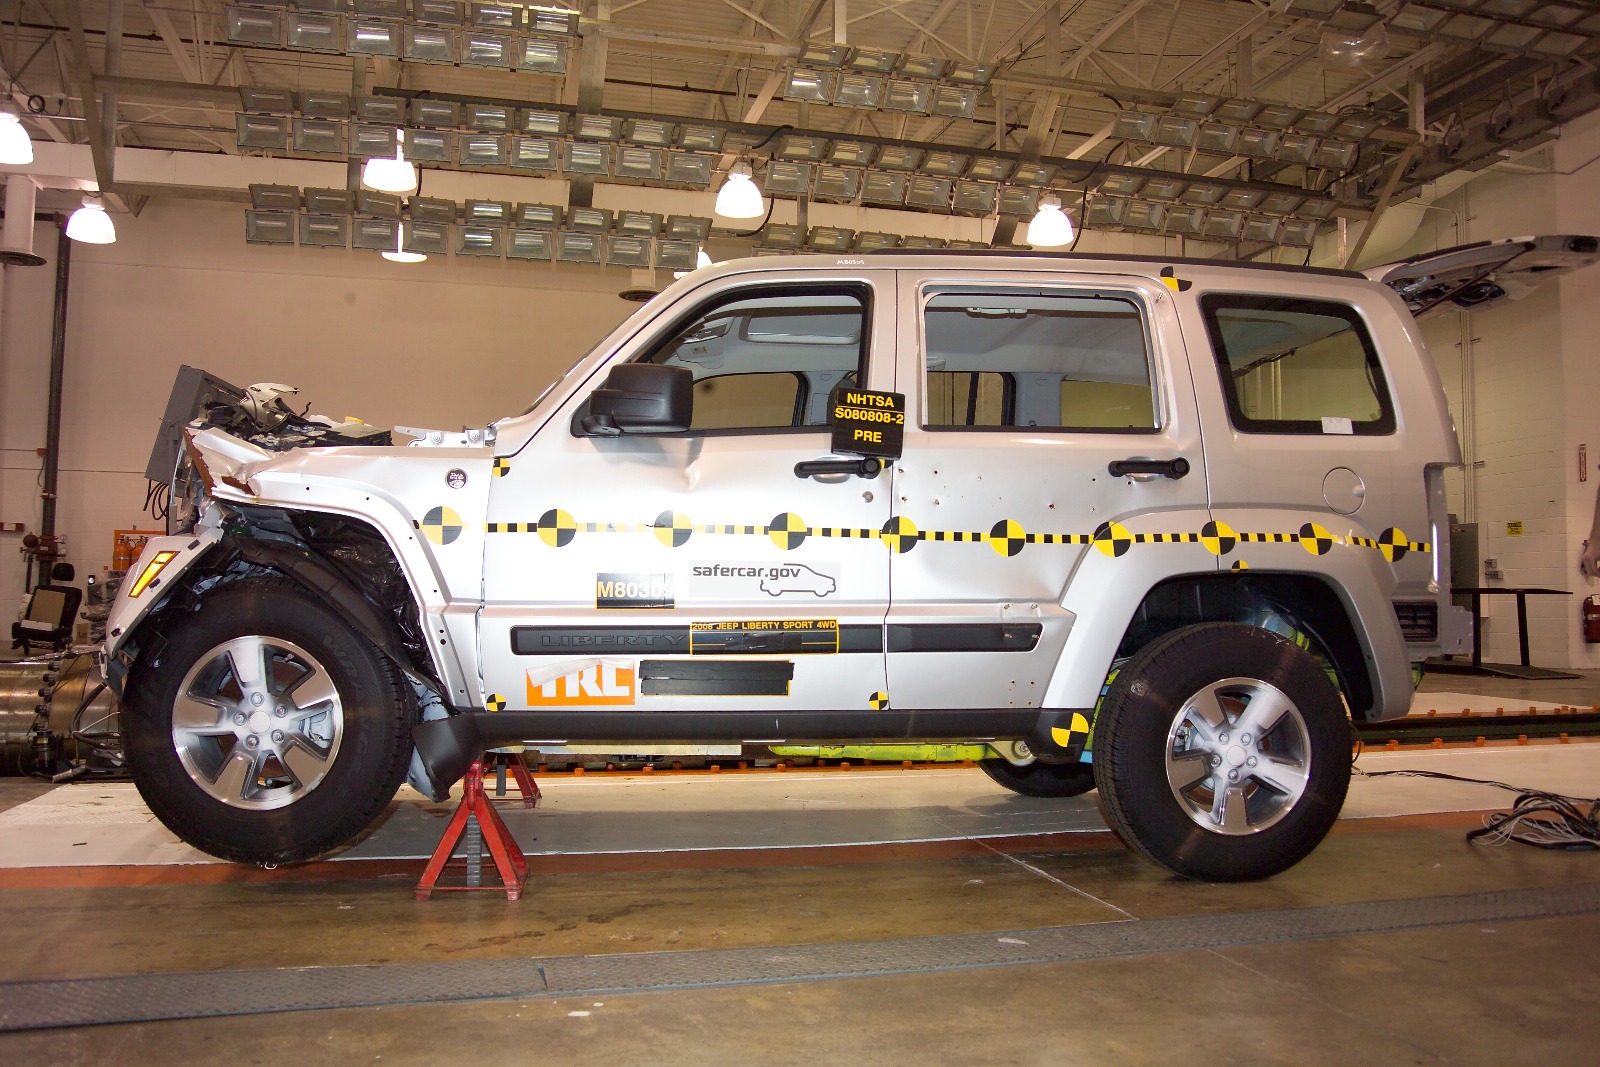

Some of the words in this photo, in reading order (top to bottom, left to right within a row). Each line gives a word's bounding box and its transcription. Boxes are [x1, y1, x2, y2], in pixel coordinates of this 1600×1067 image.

[847, 393, 894, 407] NHTSA
[835, 407, 904, 424] S080808-2
[854, 430, 882, 442] PRE
[693, 564, 801, 581] safercar.gov
[716, 622, 739, 630] JEEP
[742, 621, 780, 630] LIBERTY
[783, 620, 814, 629] SPORT
[817, 620, 837, 629] 4WD
[542, 635, 687, 646] LIBERTY
